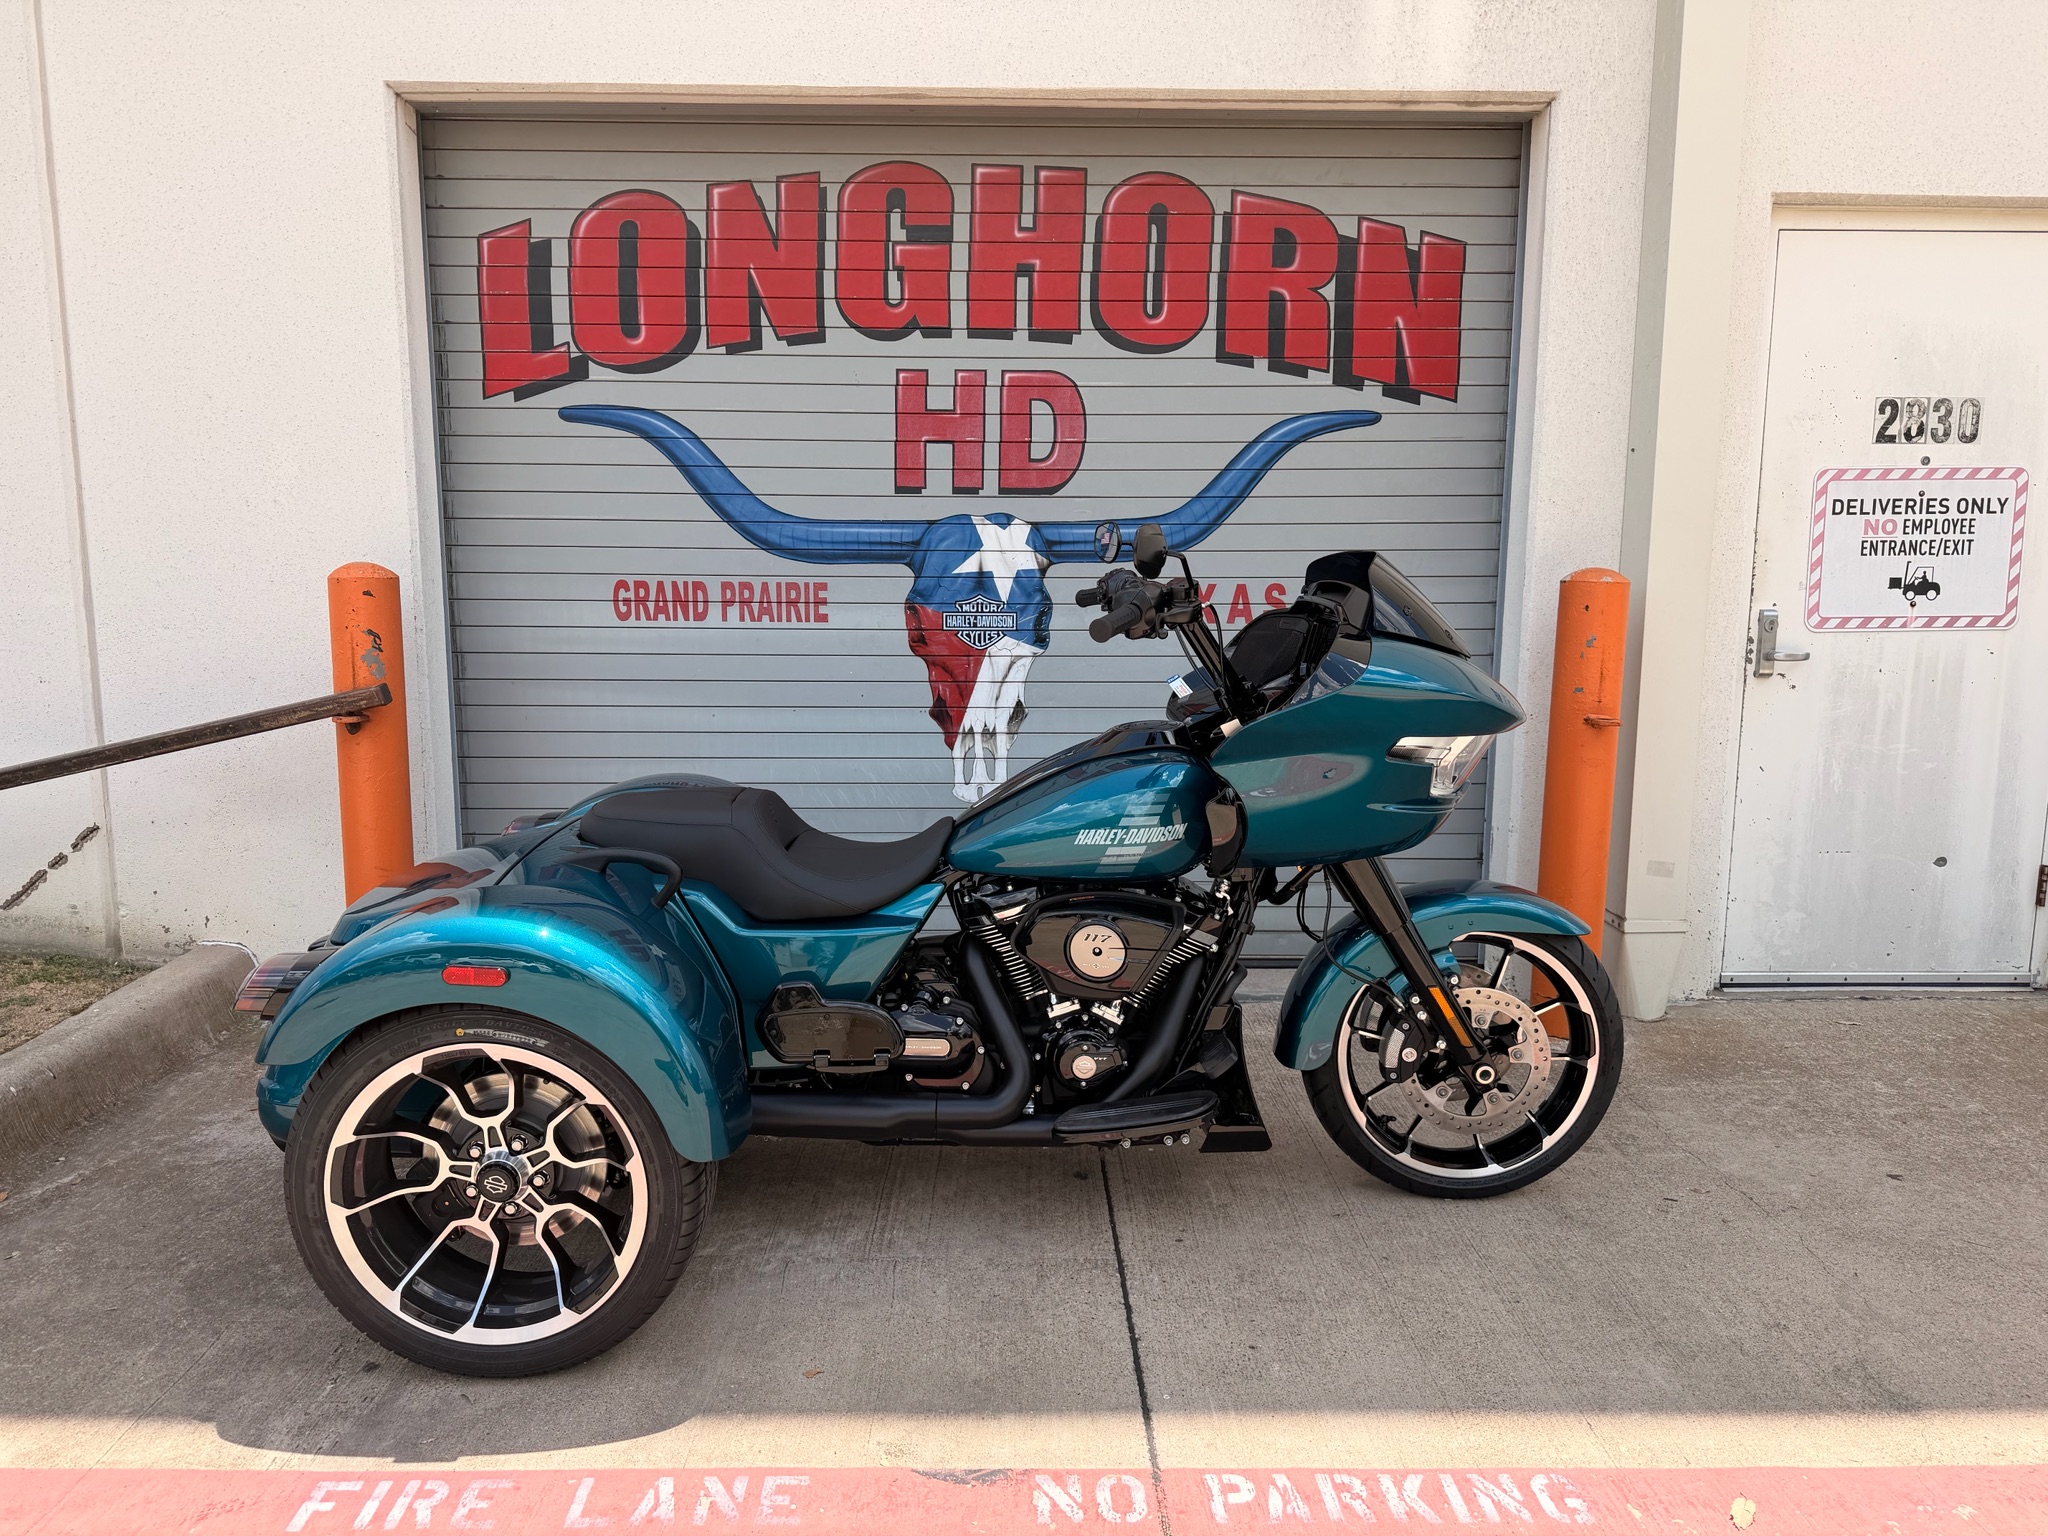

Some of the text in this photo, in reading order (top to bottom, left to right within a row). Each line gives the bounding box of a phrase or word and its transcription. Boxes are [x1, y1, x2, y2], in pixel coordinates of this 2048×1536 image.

[479, 160, 1466, 404] LONGHORN
[1876, 398, 1981, 443] 2830
[895, 368, 1086, 495] HD
[1831, 497, 2009, 515] DELIVERIES ONLY
[1863, 518, 1976, 536] NO EMPLOYEE
[1860, 538, 1974, 557] ENTRANCE/EXIT
[613, 579, 829, 623] GRAND PRAIRIE
[962, 598, 998, 612] MOTOR
[1198, 582, 1286, 624] XAS
[946, 615, 1014, 628] HARLEY-DAVIDSON
[962, 630, 998, 647] CYCLES
[1074, 823, 1188, 845] HARLEY-DAVIDSON
[1083, 933, 1112, 943] 117
[285, 1472, 1597, 1532] FIRE LANE NO PARKING
